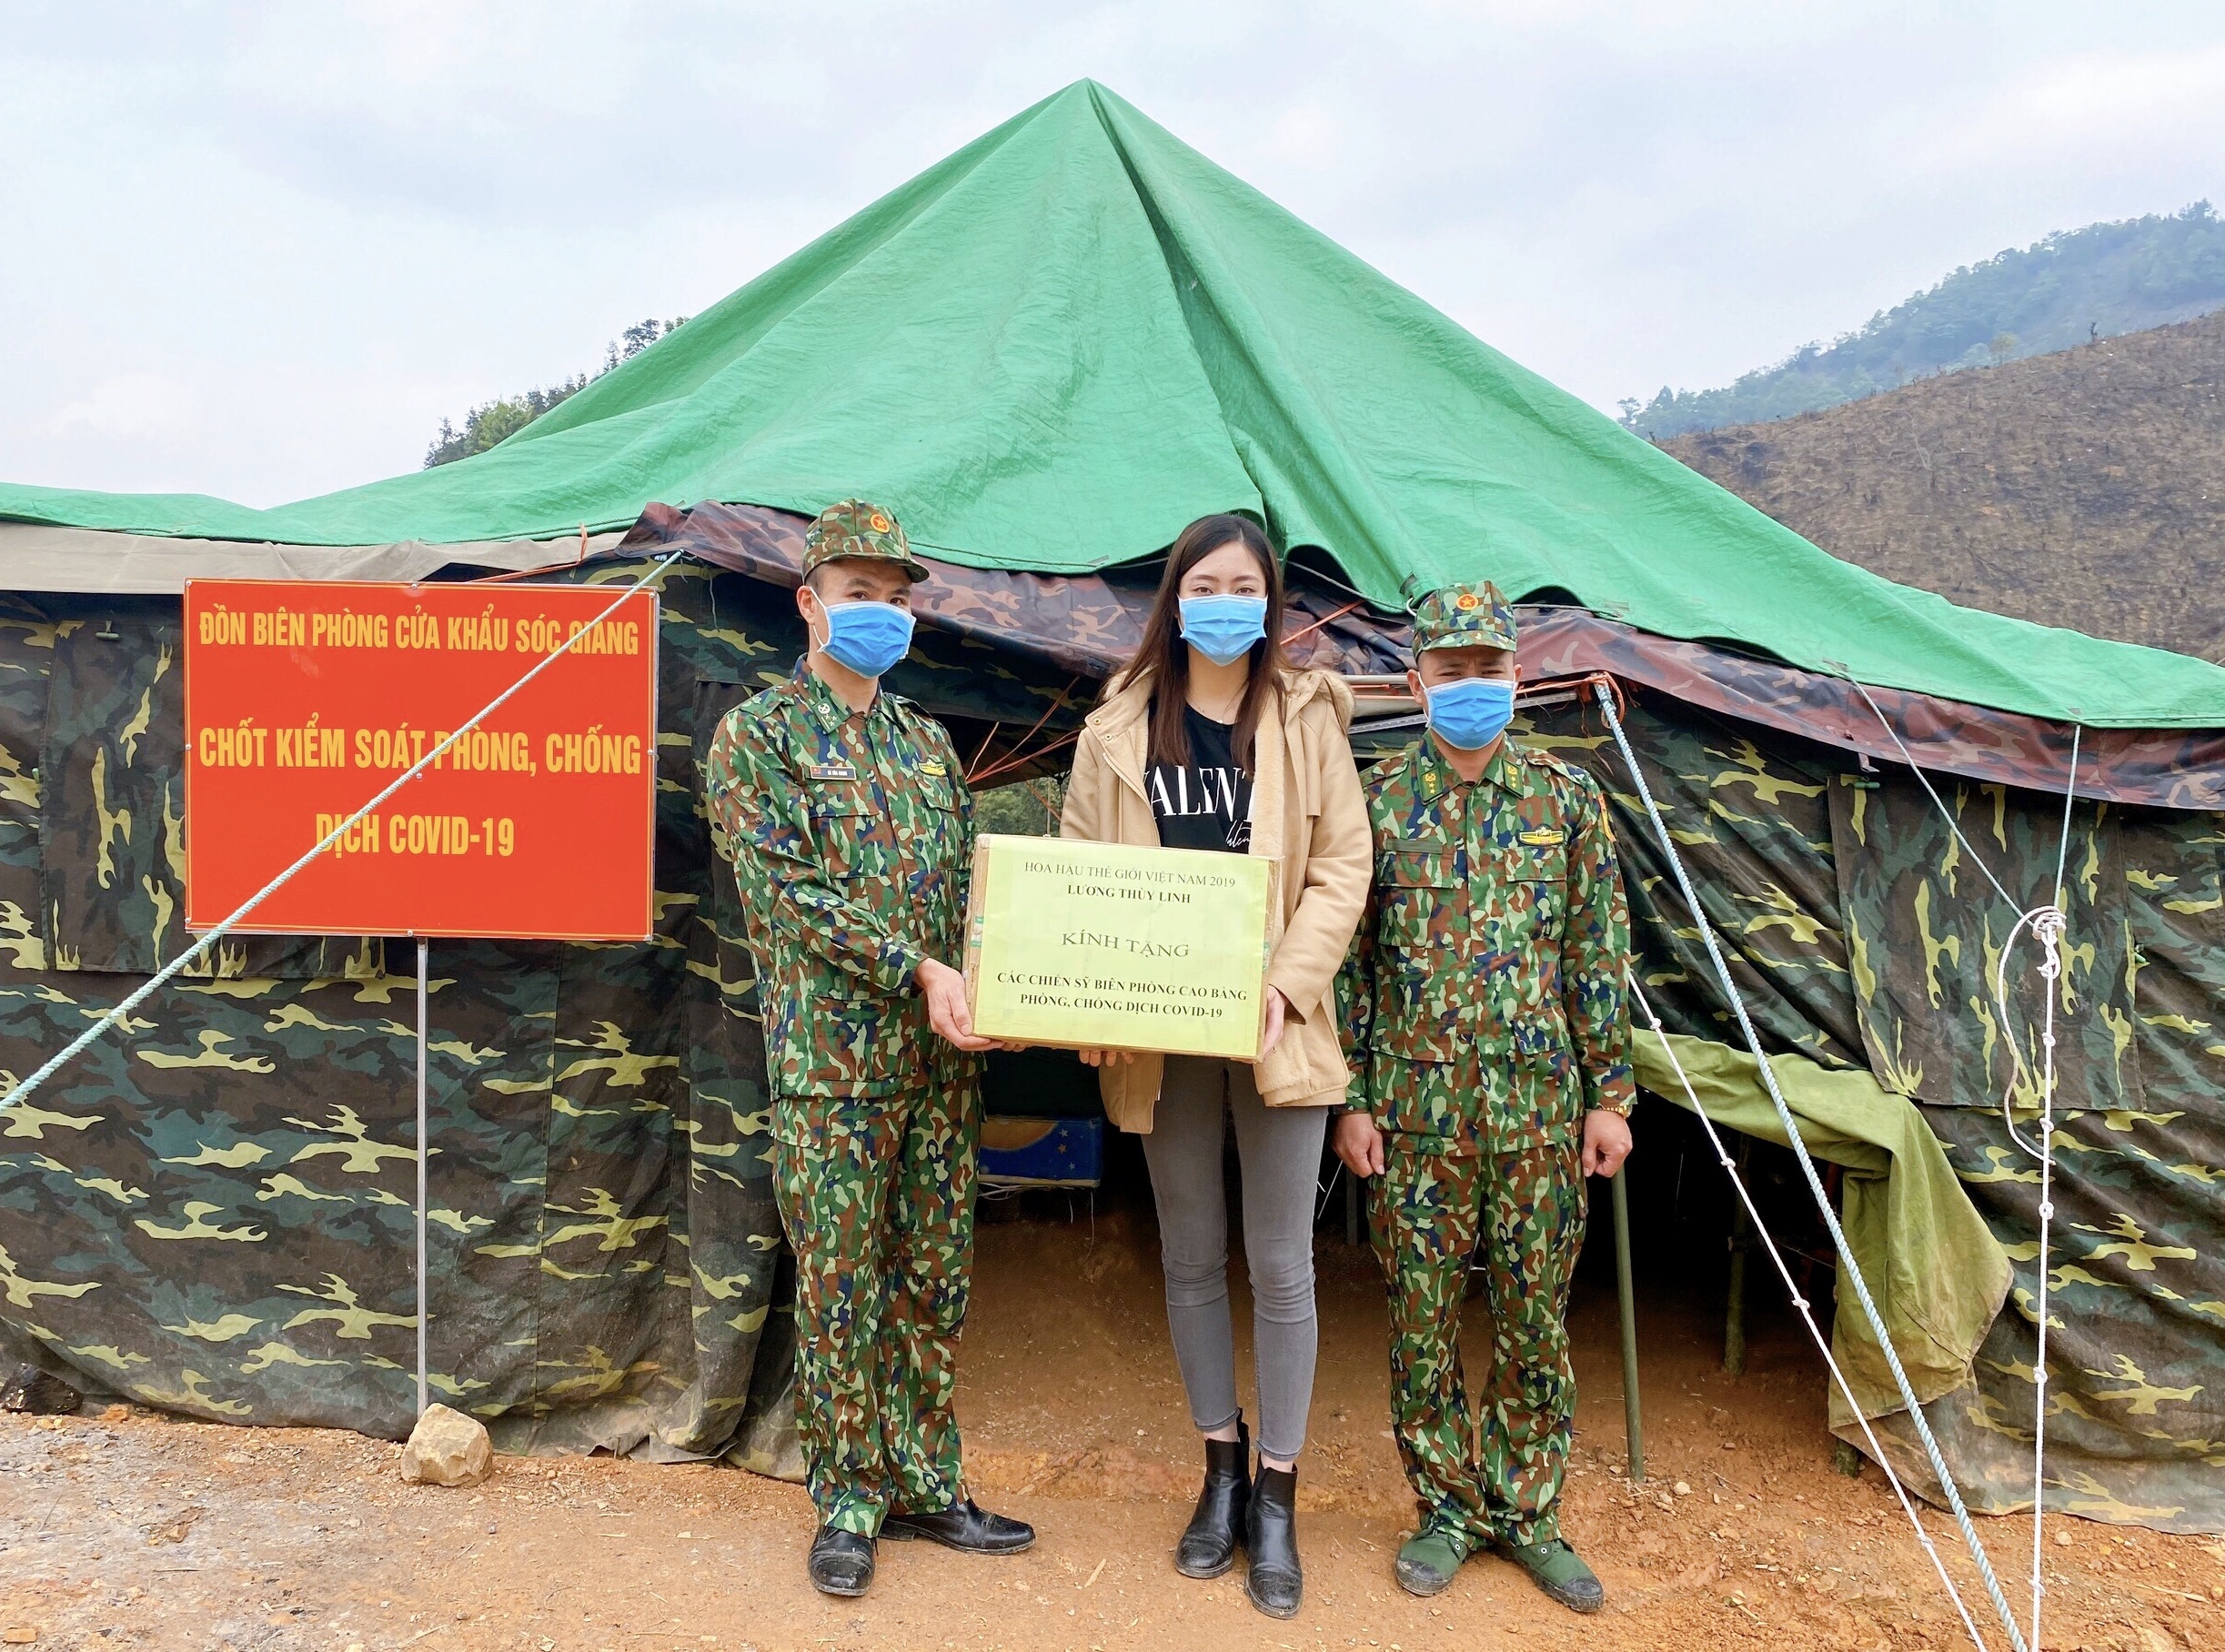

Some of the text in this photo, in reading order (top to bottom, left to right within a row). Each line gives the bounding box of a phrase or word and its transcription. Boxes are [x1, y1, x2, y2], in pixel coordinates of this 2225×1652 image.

[199, 602, 639, 655] ĐỒN BIÊN PHÒNG CỬA KHẨU SÓC GIANG
[199, 711, 641, 777] CHỐT KIỂM SOÁT PHÒNG, CHỐNG
[316, 813, 516, 859] DỊCH COVID-19
[1024, 861, 1052, 873] HOA
[1114, 867, 1142, 881] GIỚI
[1145, 871, 1174, 884] VIỆT
[1177, 873, 1207, 886] NAM
[1210, 876, 1235, 888] 2019
[1067, 884, 1191, 903] LƯƠNG THÙY LINH
[1061, 929, 1190, 958] KÍNH TẶNG
[997, 970, 1026, 984] CÁC
[1074, 976, 1092, 989] SỸ
[1094, 977, 1125, 991] BIÊN
[1129, 981, 1175, 995] PHÒNG
[1179, 985, 1207, 997] CAO
[1020, 992, 1071, 1008] PHÒNG,
[1126, 1002, 1159, 1014] DỊCH
[1163, 1004, 1223, 1018] COVID-19
